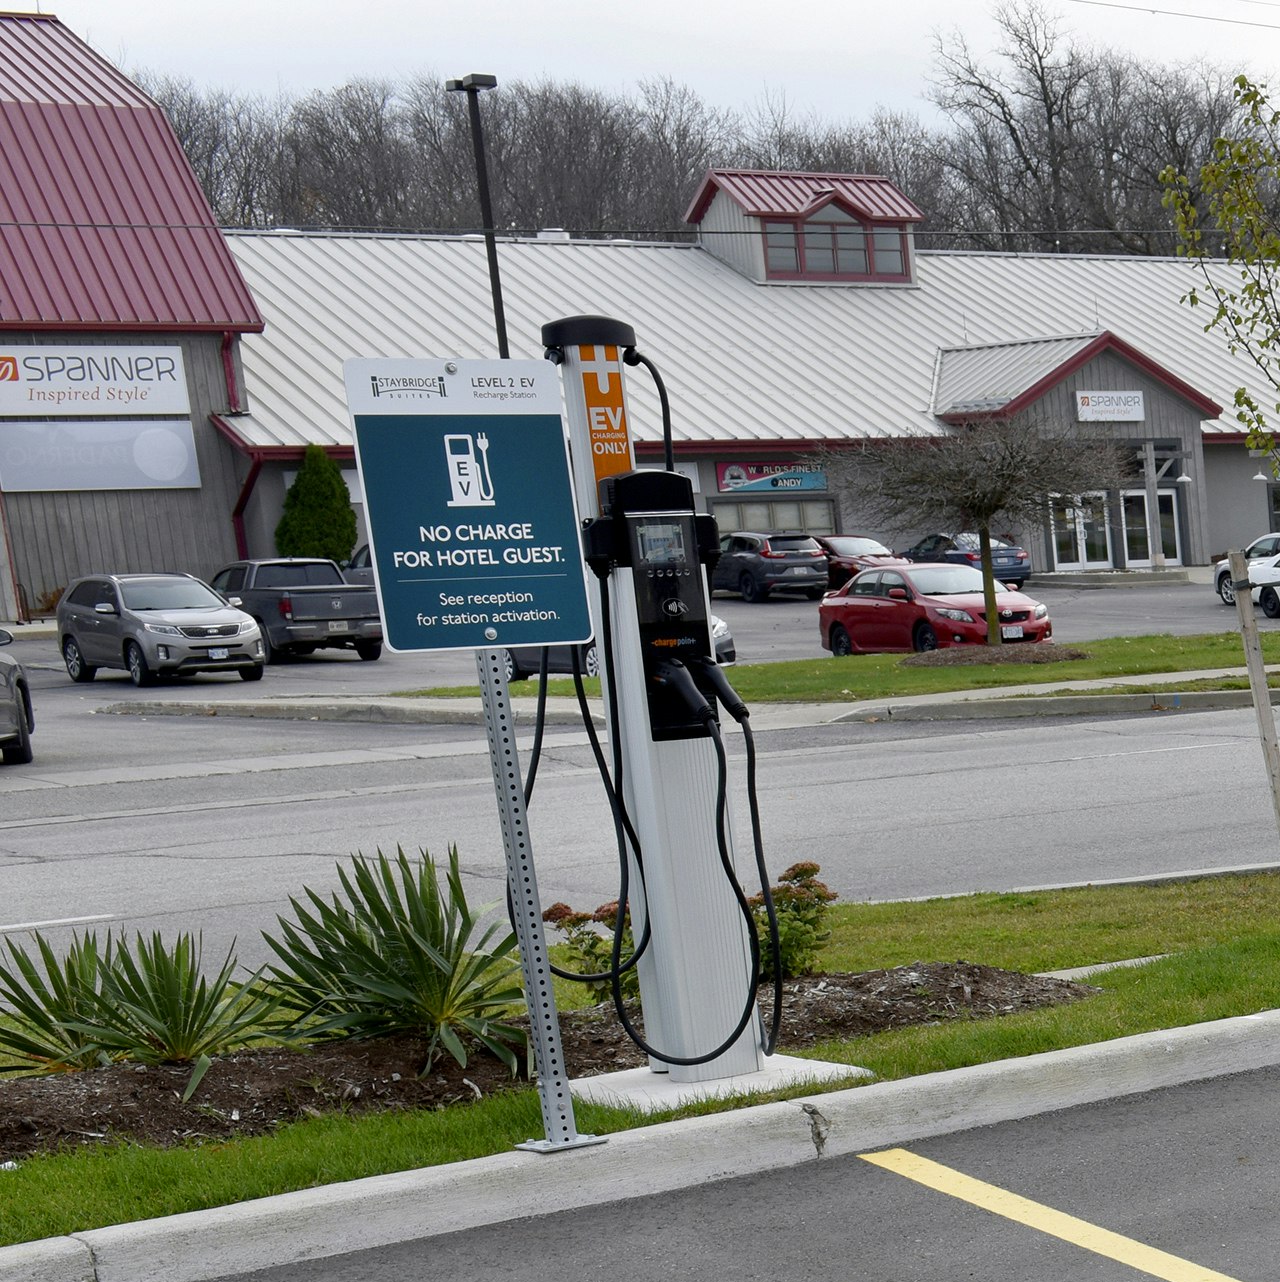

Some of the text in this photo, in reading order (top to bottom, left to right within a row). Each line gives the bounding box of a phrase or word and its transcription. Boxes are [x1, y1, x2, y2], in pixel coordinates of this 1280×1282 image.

[378, 377, 438, 388] STAYBRIDGE
[471, 377, 535, 388] LEVEL 2 EV
[28, 386, 148, 404] Inspired Style
[473, 390, 537, 400] Recharge Station
[589, 406, 623, 430] EV
[593, 441, 627, 455] ONLY
[791, 464, 822, 474] FINEST
[419, 523, 534, 542] NO CHARGE
[393, 546, 566, 568] FOR HOTEL GUEST.
[439, 591, 533, 607] See reception
[416, 609, 561, 626] for station activation.
